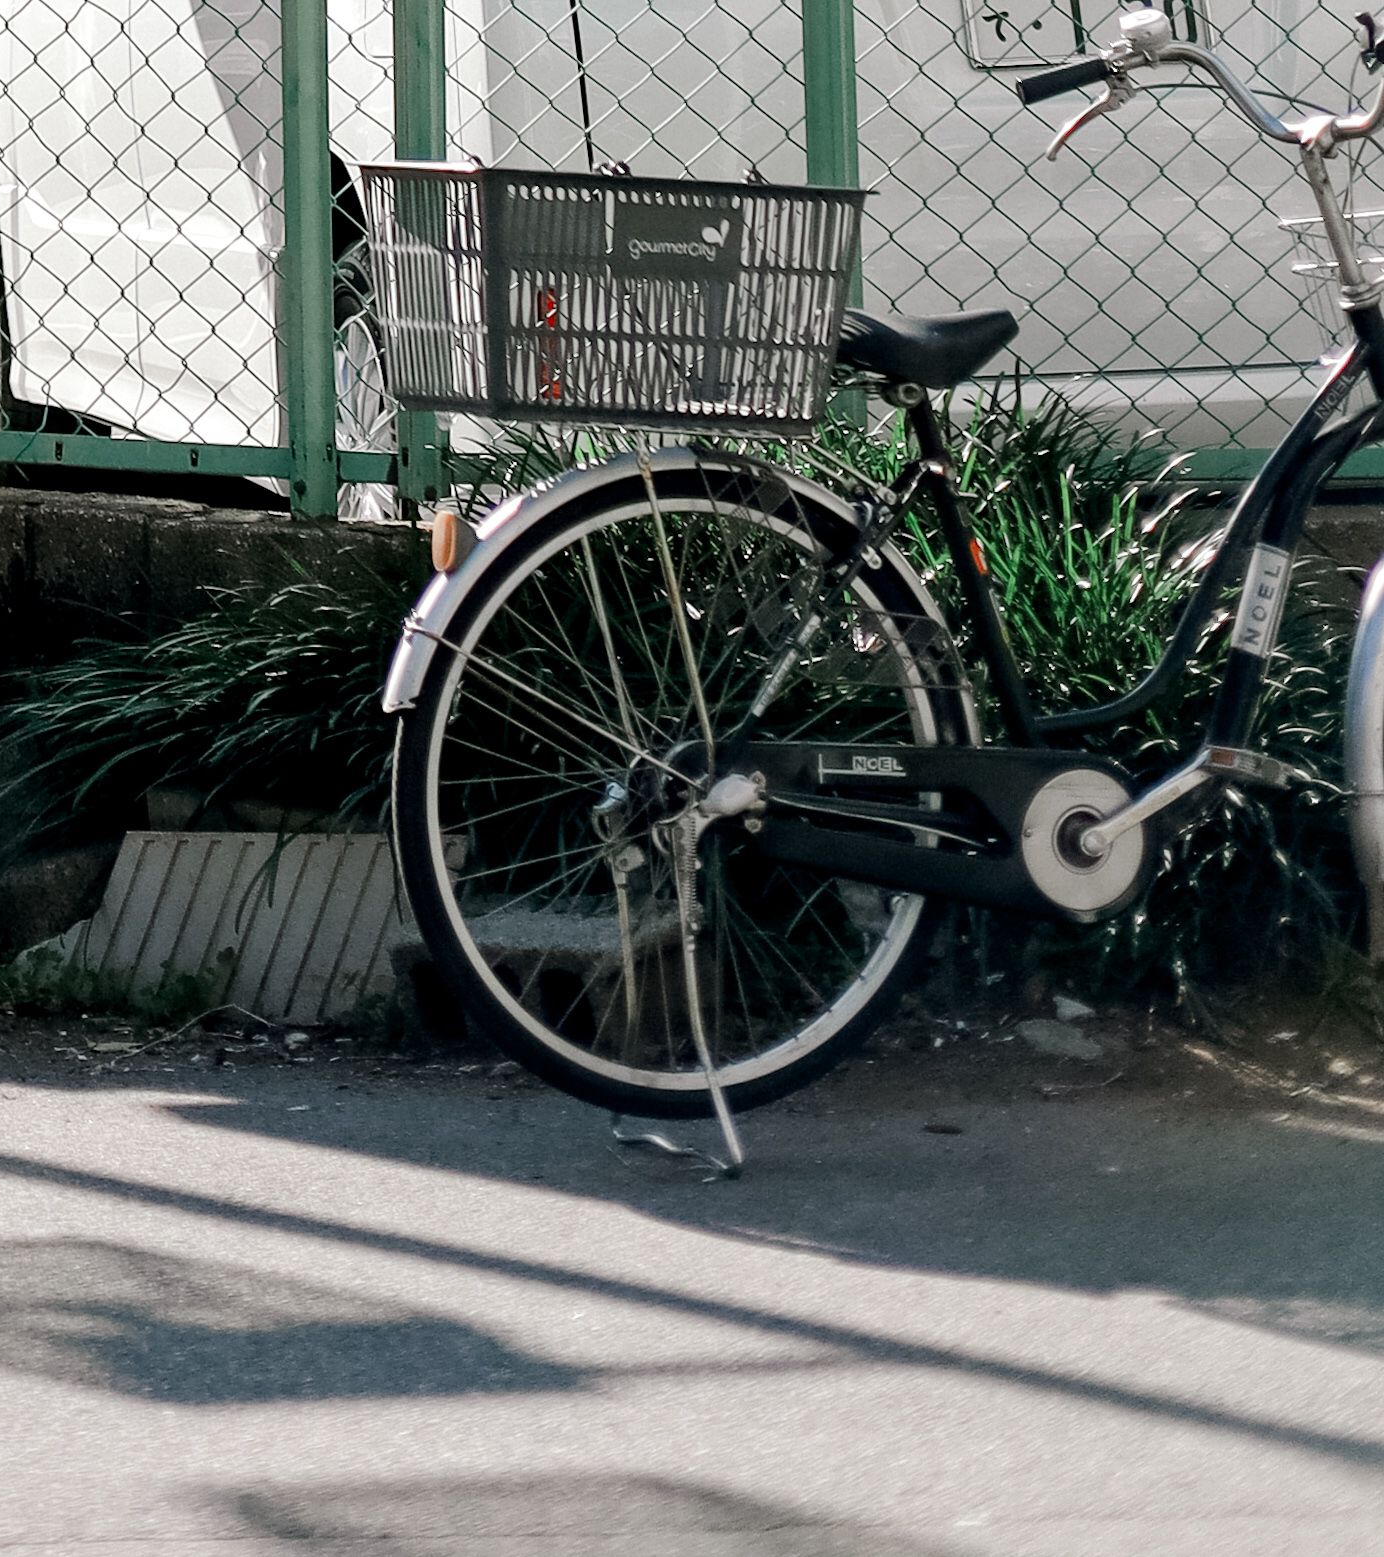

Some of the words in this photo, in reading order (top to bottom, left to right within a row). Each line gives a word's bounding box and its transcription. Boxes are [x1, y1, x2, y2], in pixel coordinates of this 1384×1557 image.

[1315, 373, 1357, 420] NOEL
[1242, 564, 1282, 647] NOEL
[853, 756, 905, 771] NOEL
